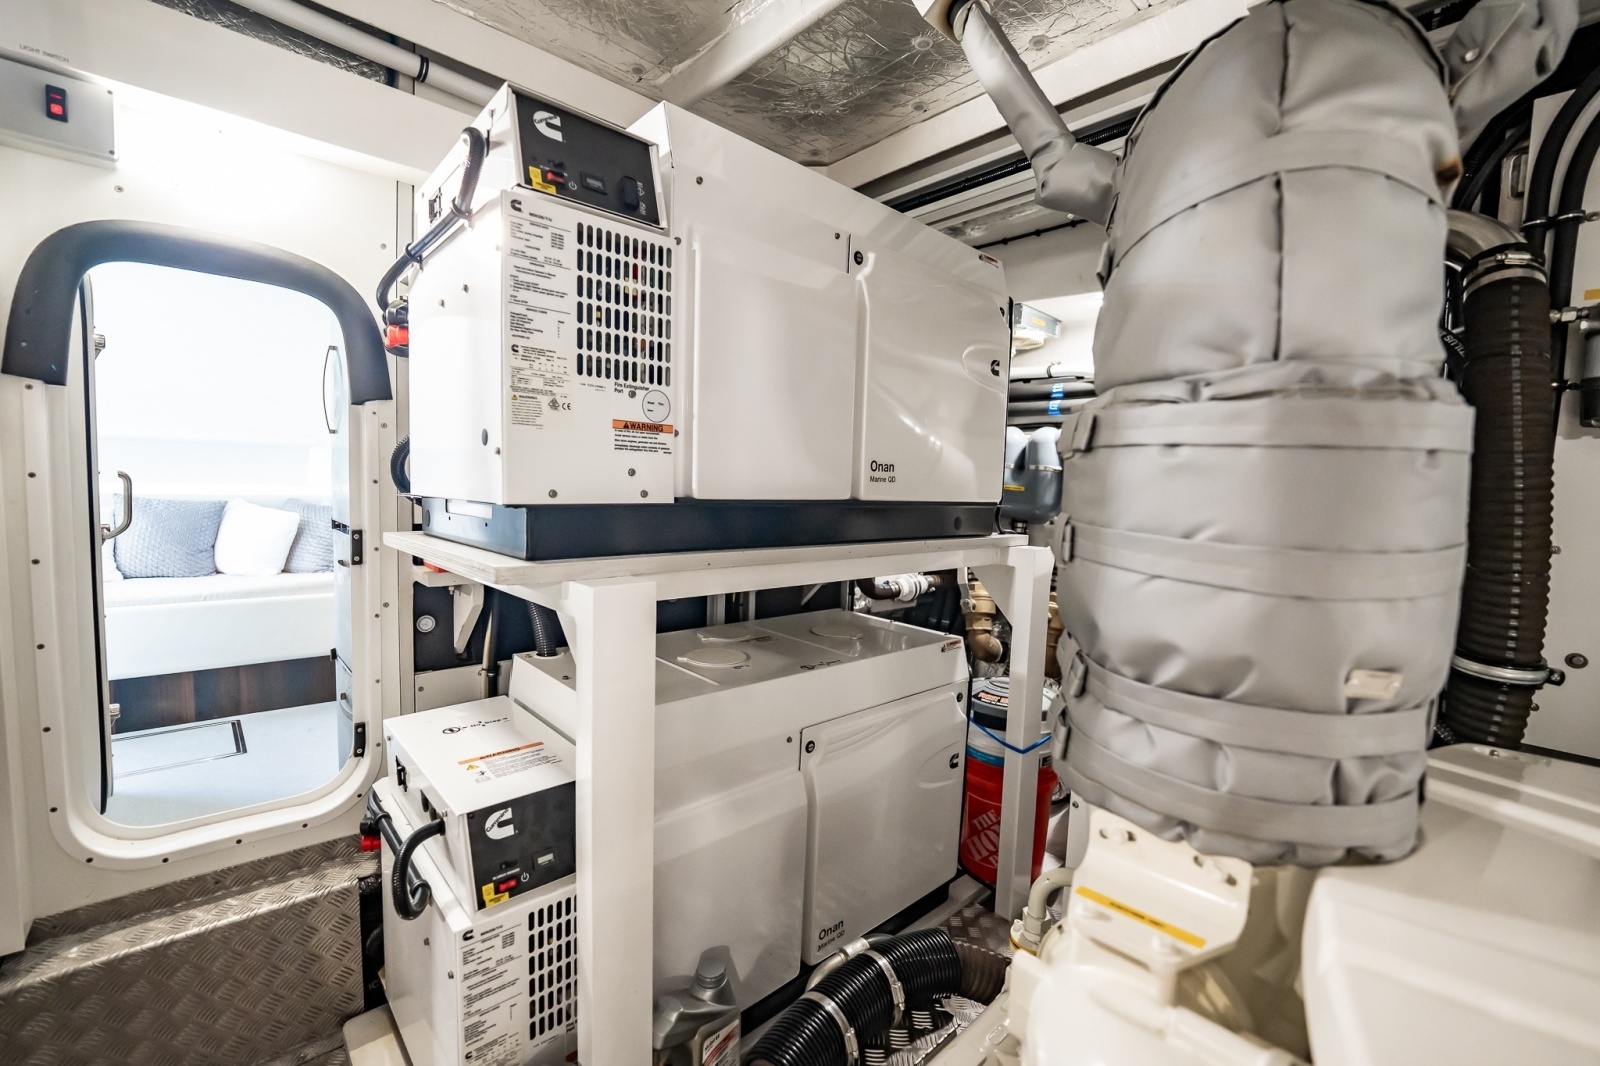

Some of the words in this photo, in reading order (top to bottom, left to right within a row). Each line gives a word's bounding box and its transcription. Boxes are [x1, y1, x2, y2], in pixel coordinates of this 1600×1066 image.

[19, 44, 40, 55] LIGHT
[42, 51, 70, 63] SWITCH
[533, 114, 558, 124] Cummins
[630, 422, 663, 432] WARNING
[870, 460, 894, 472] Onan
[485, 808, 509, 833] Cummins
[972, 810, 1000, 831] THE
[818, 920, 844, 940] Onan
[817, 936, 835, 952] Marine
[837, 930, 845, 939] QD
